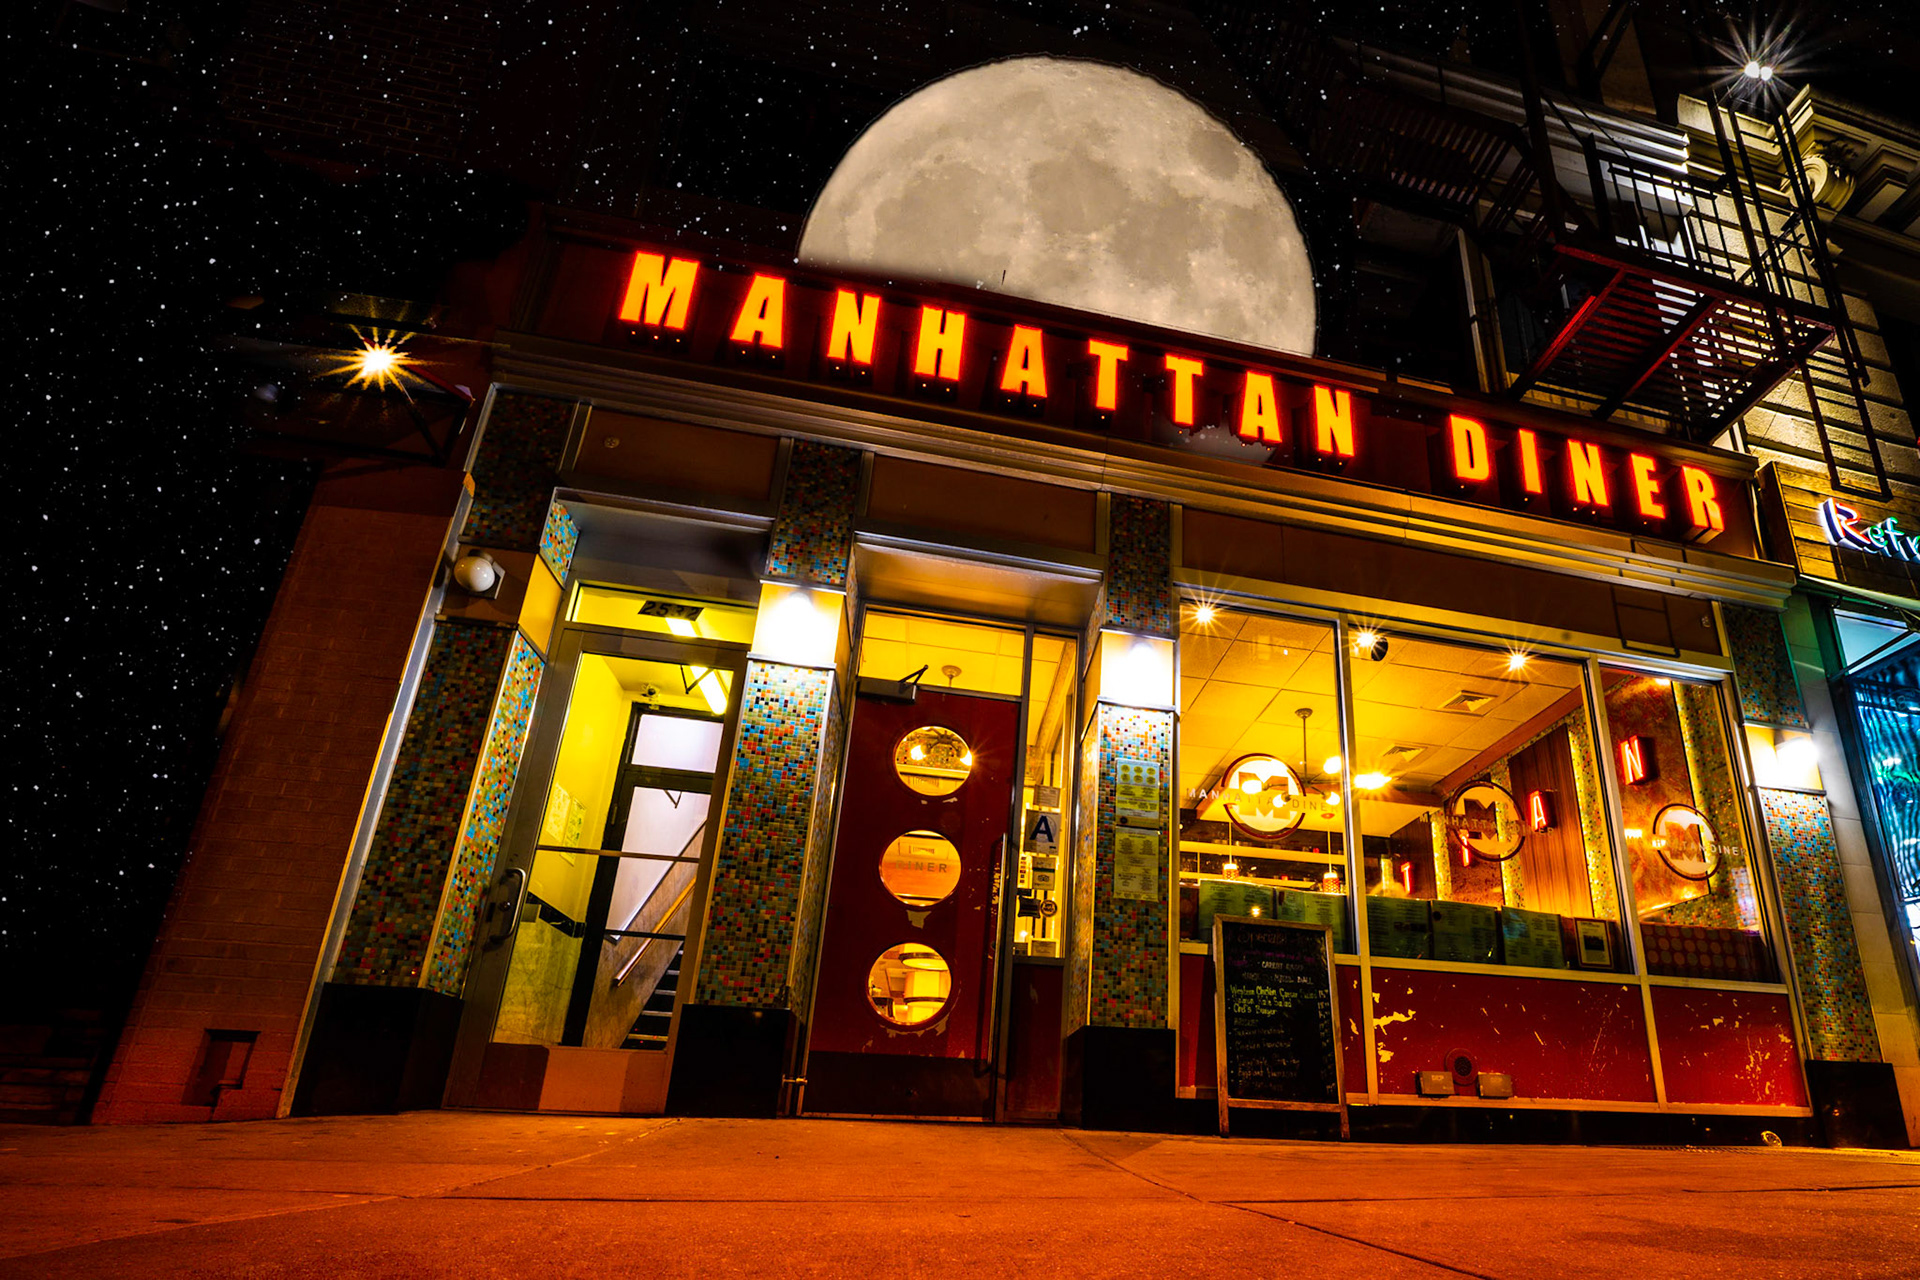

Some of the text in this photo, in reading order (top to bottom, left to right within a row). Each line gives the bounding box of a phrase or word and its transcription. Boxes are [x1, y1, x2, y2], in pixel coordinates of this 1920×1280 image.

[618, 250, 1726, 540] MANHATTAN DINER
[1186, 787, 1340, 813] MANHATTA DINER
[1028, 814, 1055, 843] A
[895, 859, 948, 873] DINER
